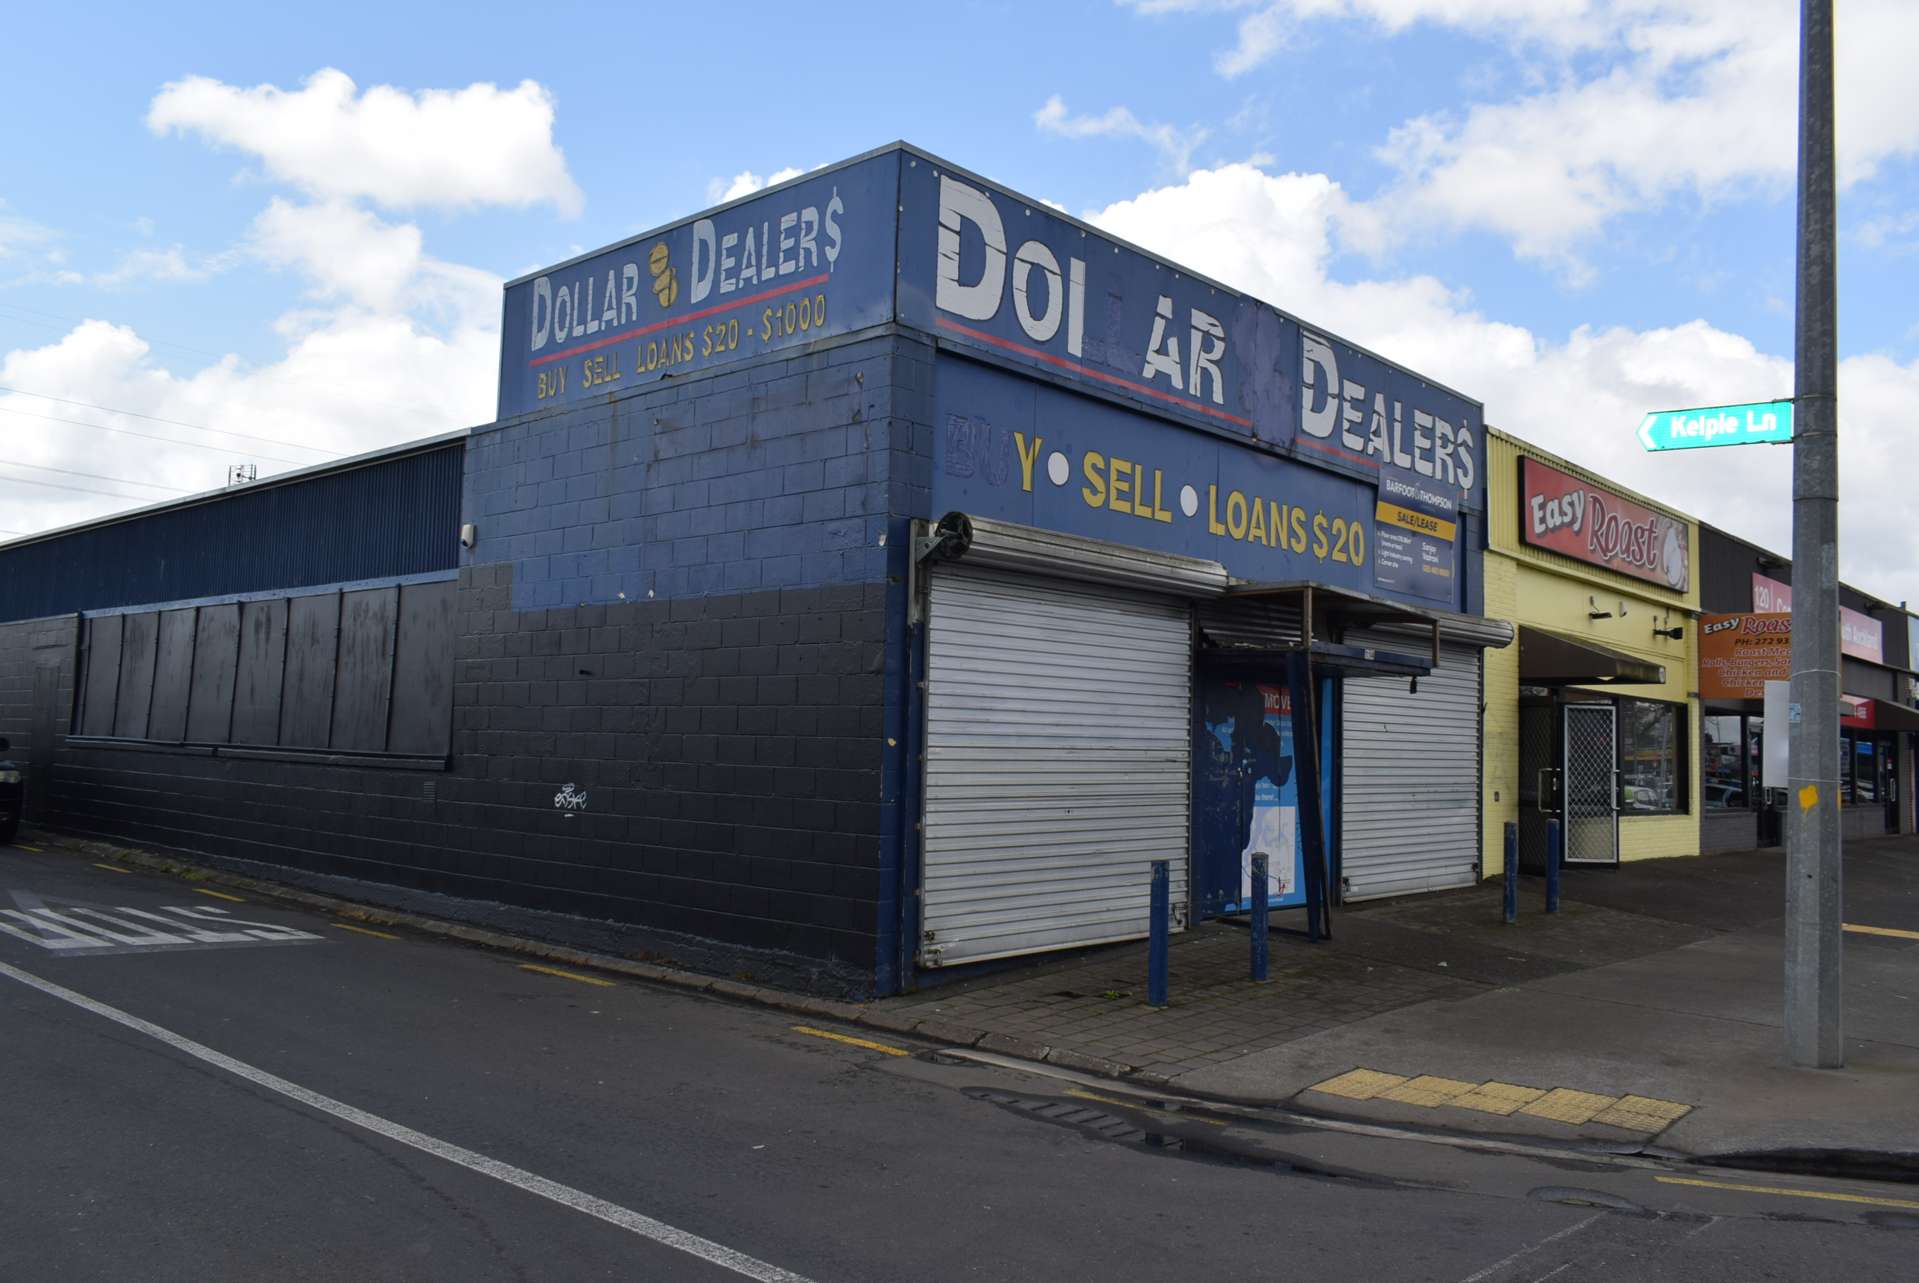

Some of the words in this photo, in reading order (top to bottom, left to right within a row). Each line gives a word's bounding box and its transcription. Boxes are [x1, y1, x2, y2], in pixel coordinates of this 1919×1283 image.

[531, 263, 639, 351] DOLLAR
[537, 366, 568, 400] BUY
[582, 355, 622, 389] SELL
[636, 330, 696, 373] LOANS
[702, 318, 739, 358] $20
[761, 294, 826, 343] $1000
[1670, 413, 1739, 441] Kelpie
[1746, 410, 1777, 432] Ln
[1082, 451, 1172, 524] SELL
[1208, 484, 1307, 554] LOANS
[1312, 510, 1365, 567] $20
[1531, 490, 1585, 535] Easy
[1588, 493, 1659, 569] Roast
[1704, 617, 1740, 635] Easy
[1740, 616, 1792, 635] Roas
